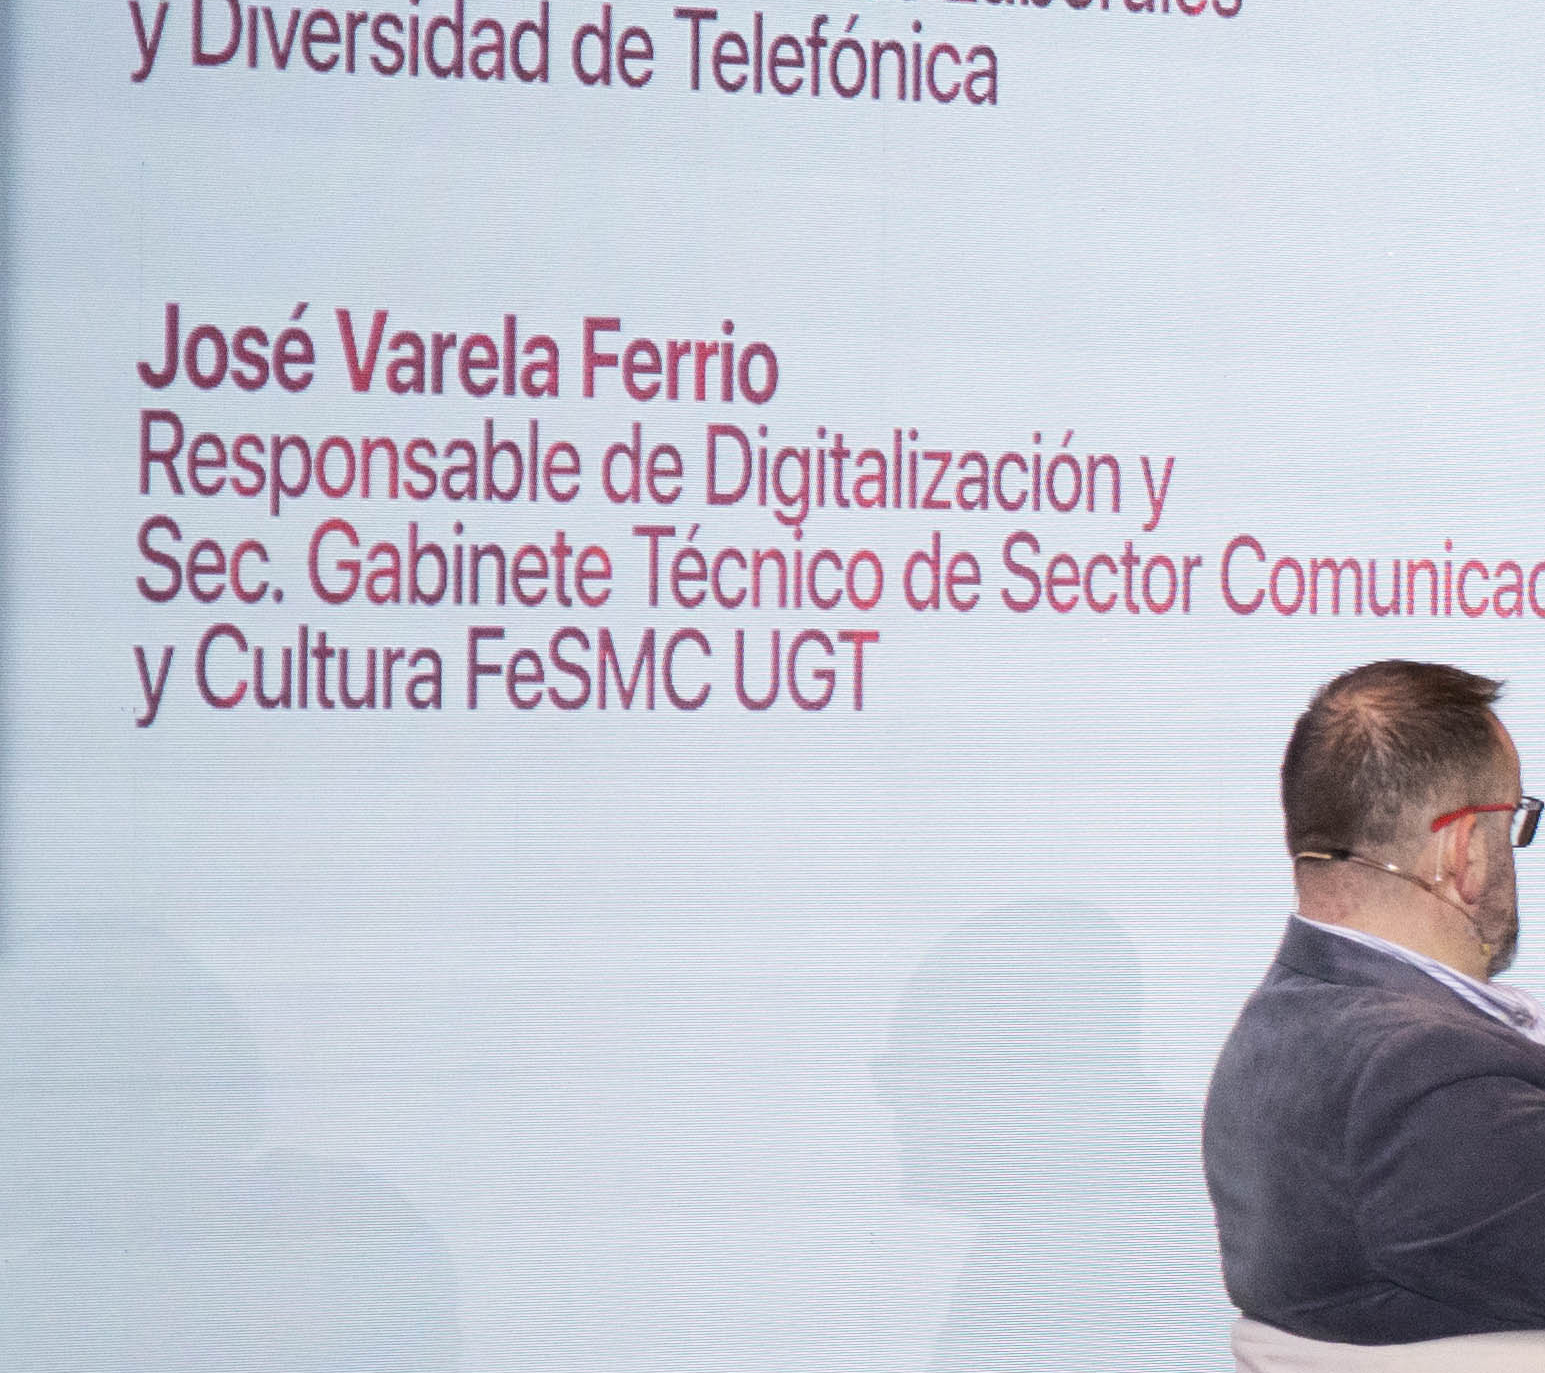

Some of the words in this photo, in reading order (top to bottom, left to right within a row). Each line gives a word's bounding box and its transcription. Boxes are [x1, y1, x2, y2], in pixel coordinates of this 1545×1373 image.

[129, 0, 169, 83] y
[572, 4, 655, 89] de
[674, 7, 998, 105] Telefónica
[137, 302, 316, 393] José
[336, 308, 560, 398] Varela
[583, 316, 779, 405] Ferrio
[140, 409, 581, 516] Responsable
[602, 423, 684, 505] de
[707, 424, 1121, 524] Digitalización
[1142, 457, 1174, 532] y
[137, 514, 284, 604] Sec.
[308, 518, 612, 608] Gabinete
[633, 525, 884, 611] Técnico
[903, 532, 981, 612] de
[1002, 535, 1202, 614] Sector
[134, 646, 174, 728] y
[195, 623, 443, 710] Cultura
[468, 626, 711, 711] FeSMC
[735, 629, 880, 711] UGT
